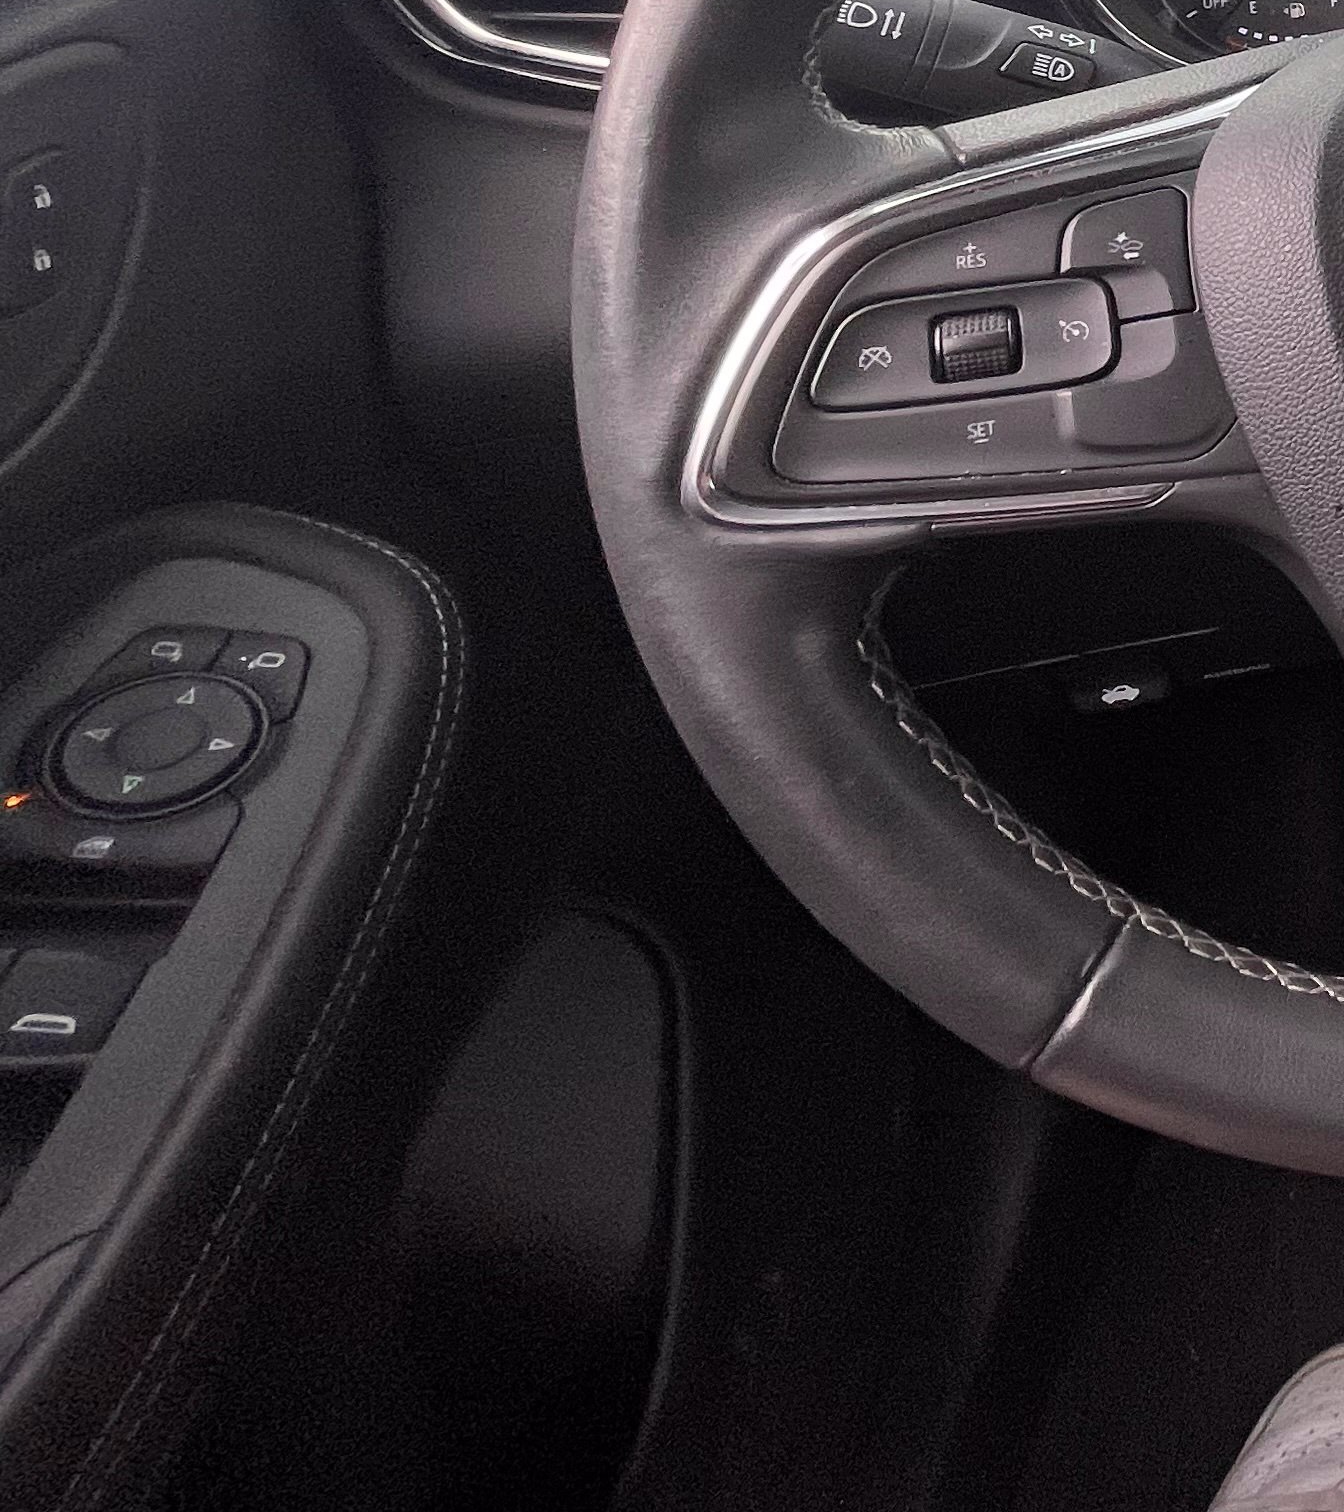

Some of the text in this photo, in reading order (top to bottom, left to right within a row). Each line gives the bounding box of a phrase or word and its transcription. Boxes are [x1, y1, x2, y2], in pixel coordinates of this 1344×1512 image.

[1249, 0, 1258, 15] E
[955, 252, 988, 270] RES
[967, 419, 997, 440] SET
